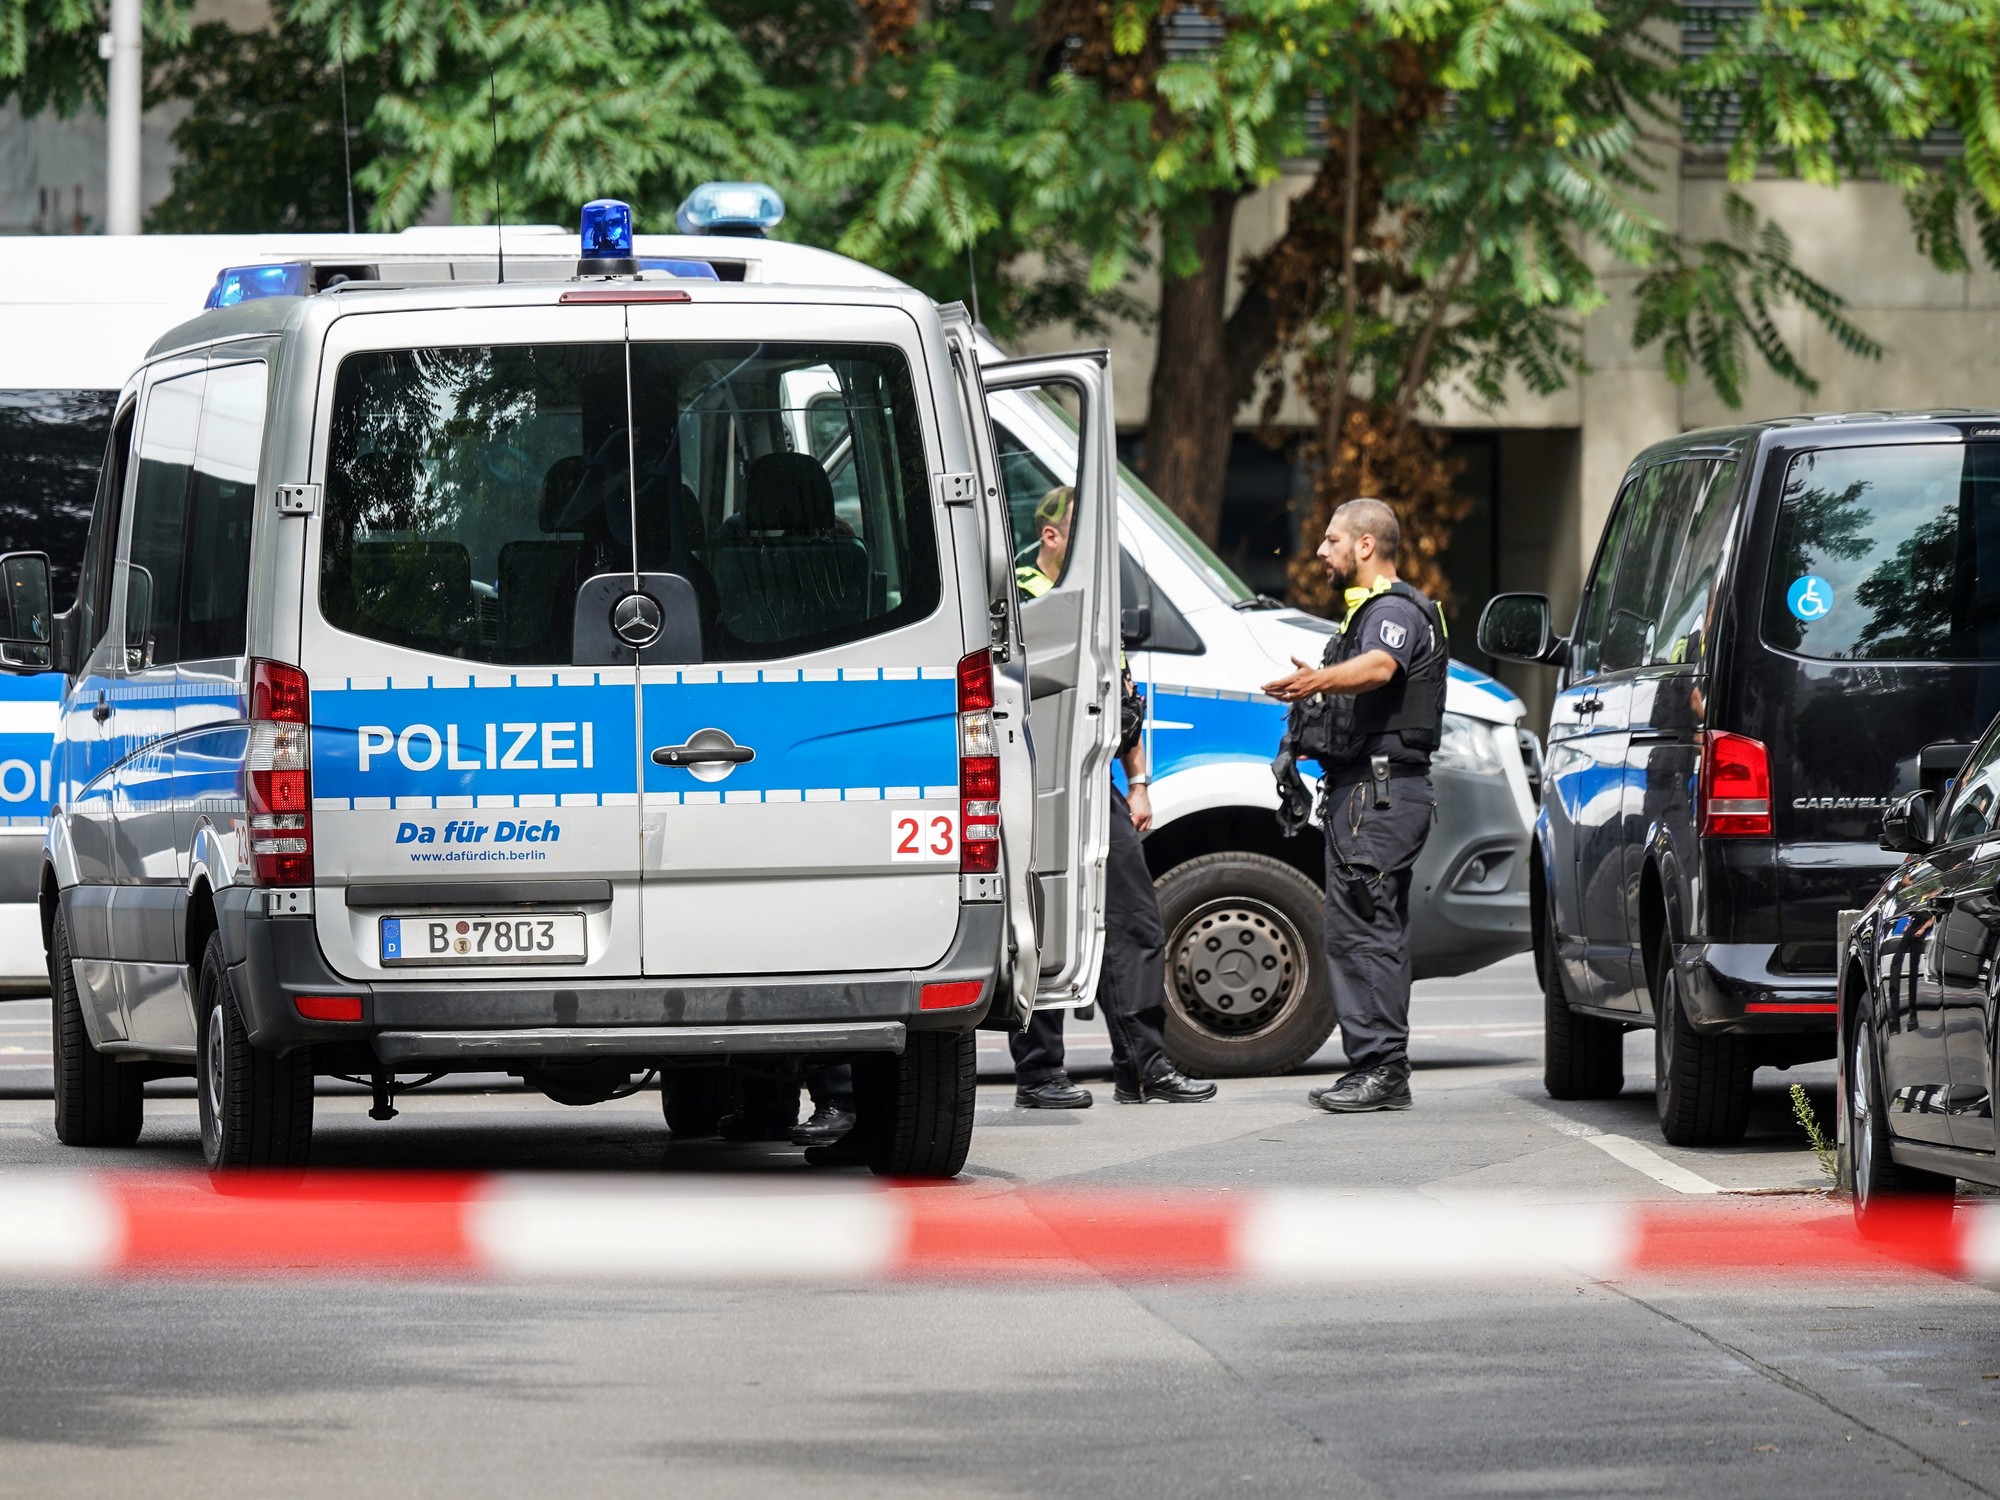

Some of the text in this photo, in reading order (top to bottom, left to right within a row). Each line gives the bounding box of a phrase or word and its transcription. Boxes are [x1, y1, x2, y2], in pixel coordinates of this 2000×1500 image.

[358, 721, 594, 772] POLIZEI
[395, 819, 561, 844] Da für Dich
[897, 816, 954, 856] 23
[410, 850, 546, 862] www.dafürdich.berlin
[388, 943, 397, 953] D
[428, 920, 555, 953] B 7803
